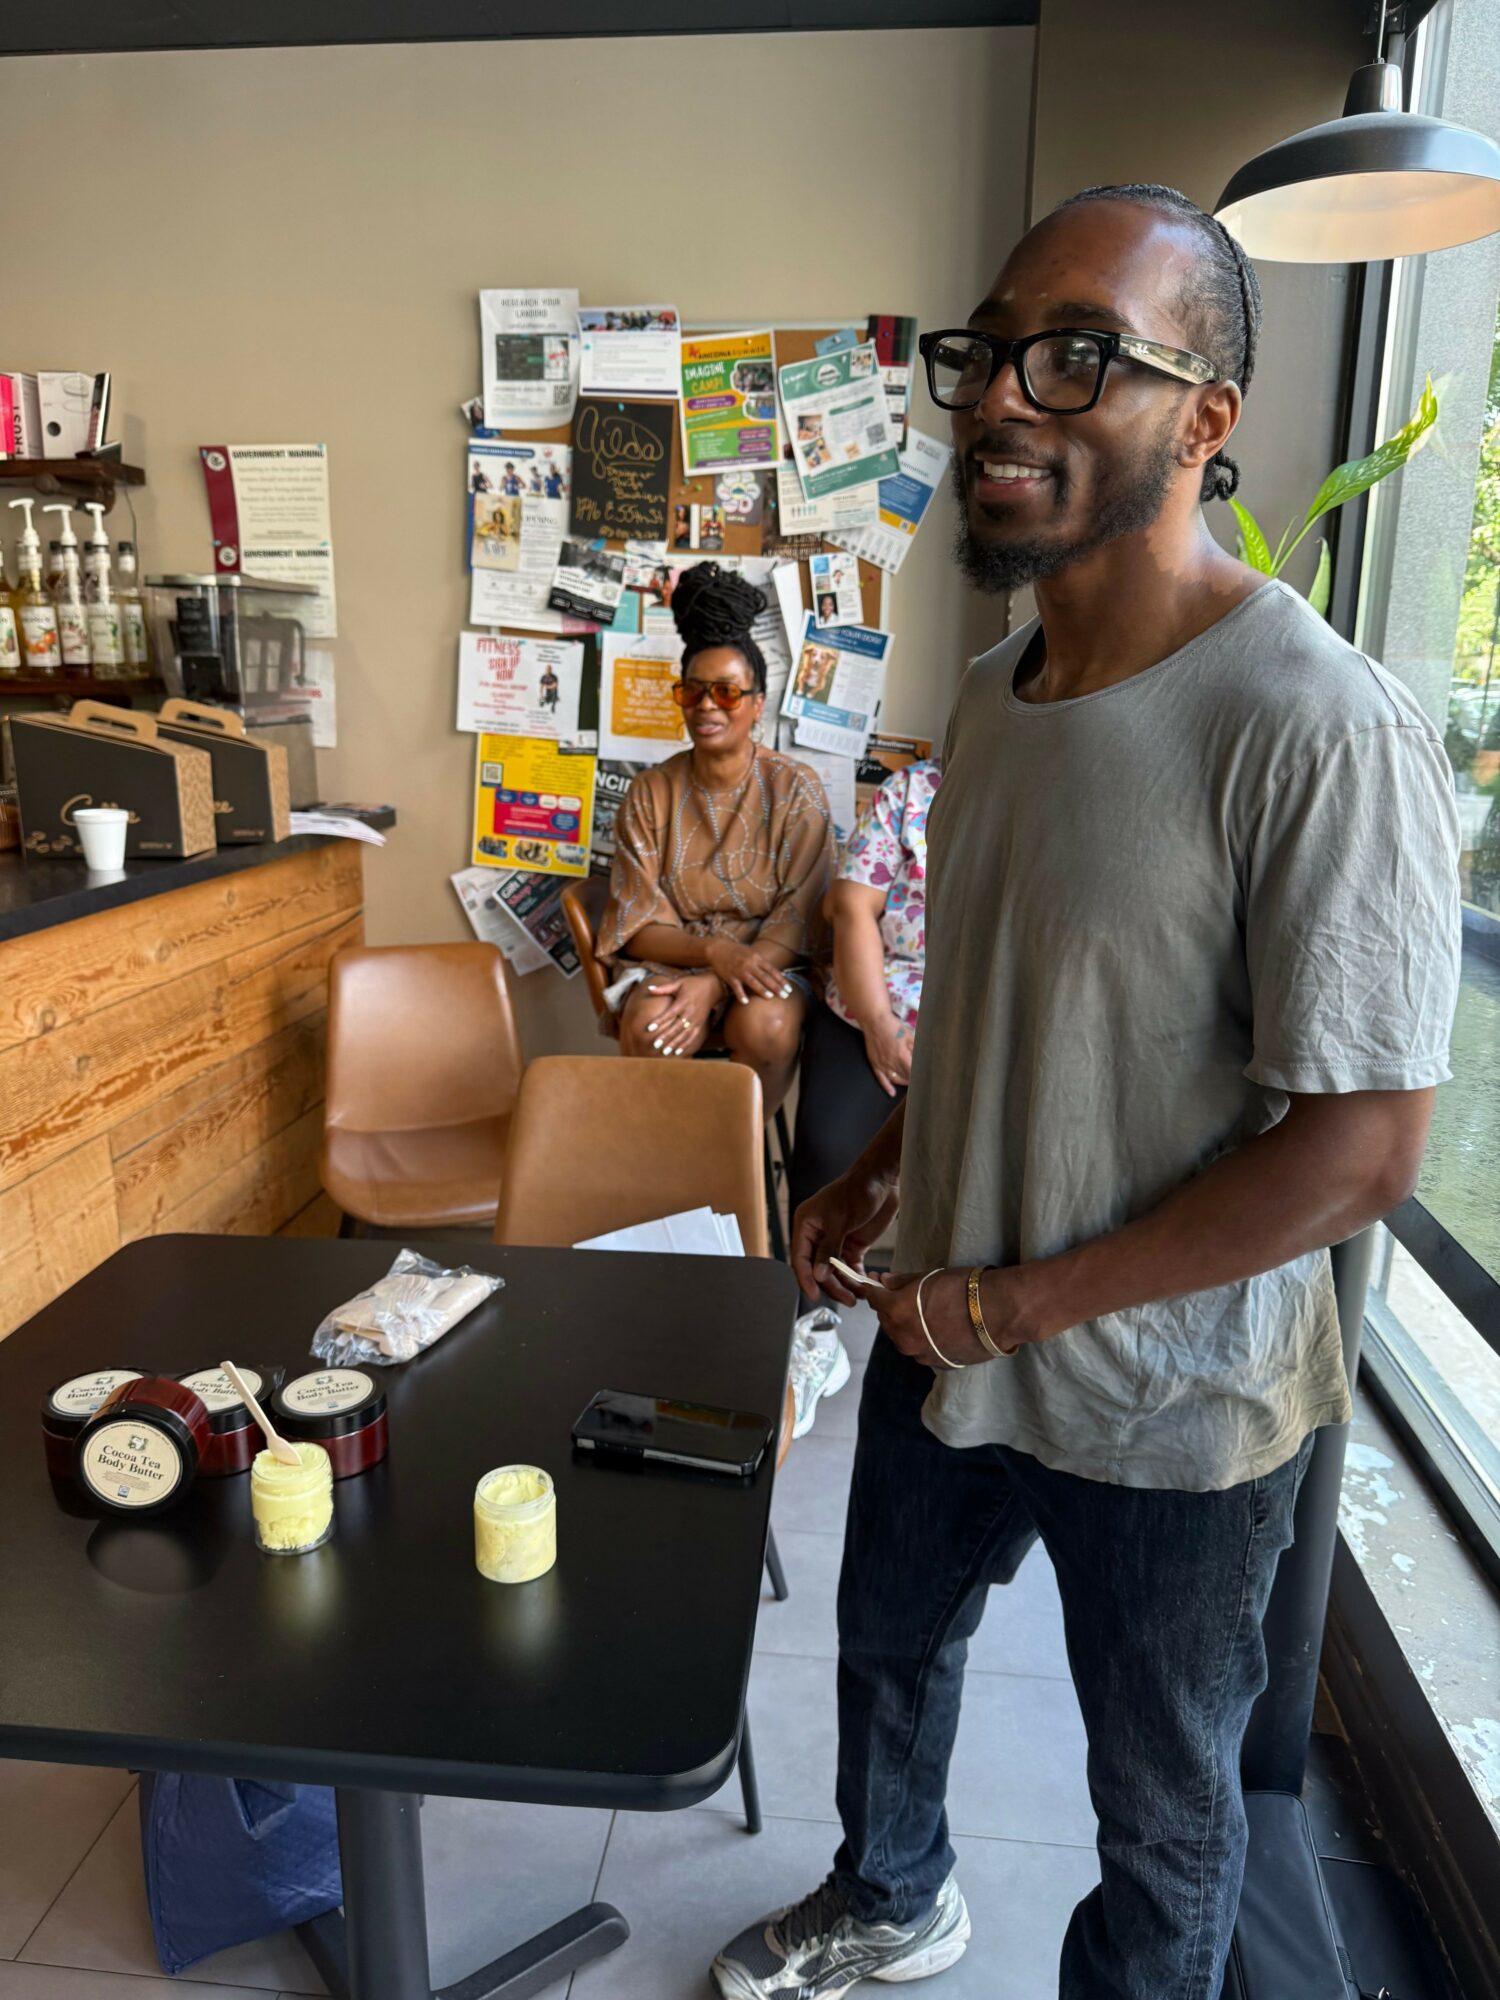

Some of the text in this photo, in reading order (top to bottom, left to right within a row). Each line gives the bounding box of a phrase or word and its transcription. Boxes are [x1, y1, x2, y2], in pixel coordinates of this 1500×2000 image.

[232, 449, 286, 459] GOVERNMENT
[243, 549, 294, 558] GOVERNMENT
[476, 637, 521, 656] FITNESS
[102, 1444, 161, 1470] Cocoa Tea
[97, 1454, 165, 1481] Body Butter
